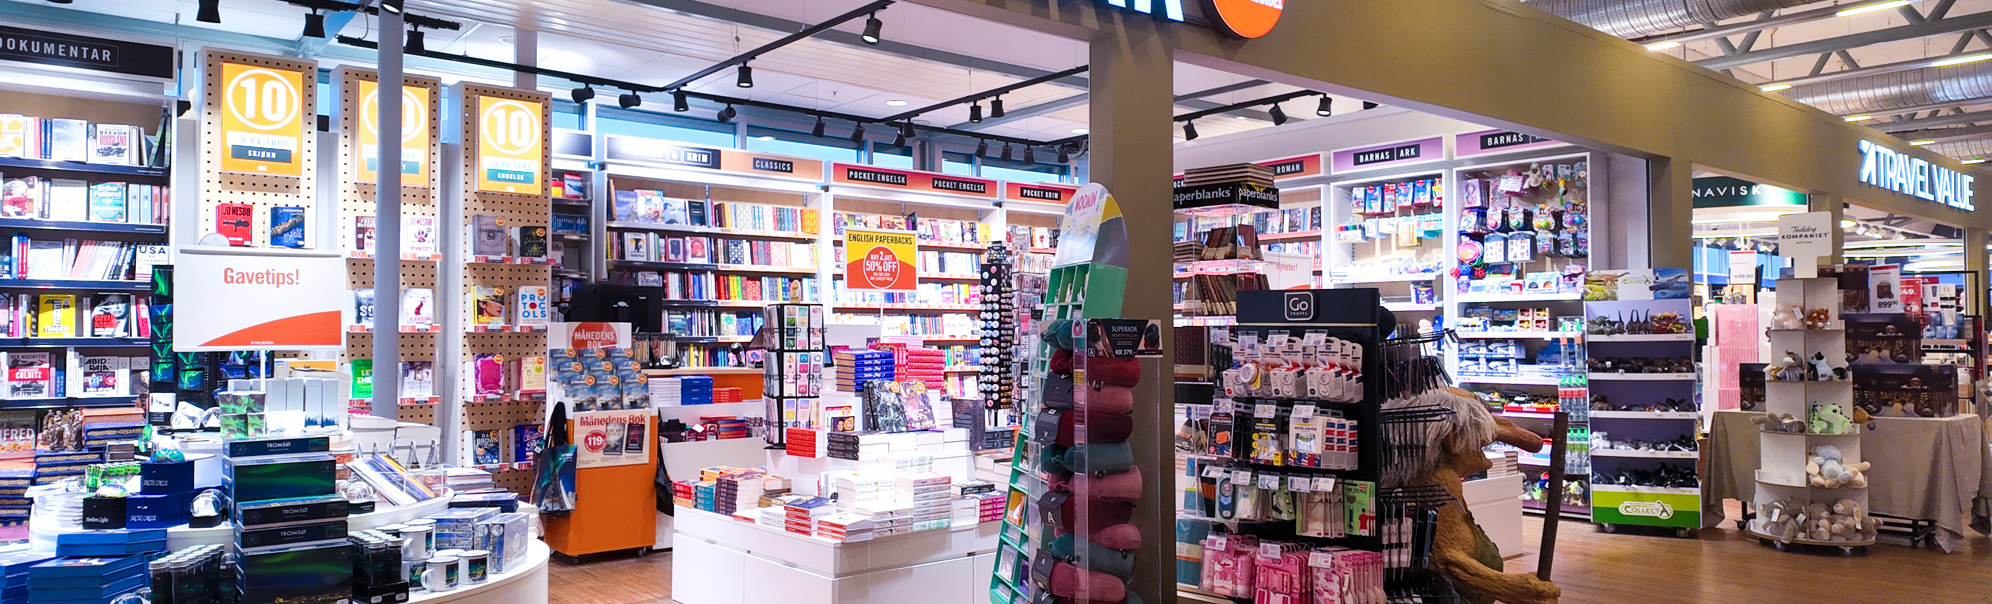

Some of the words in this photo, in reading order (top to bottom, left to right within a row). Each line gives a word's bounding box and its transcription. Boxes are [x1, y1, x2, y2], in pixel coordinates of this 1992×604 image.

[0, 37, 111, 62] OKUMENTAR
[240, 77, 286, 122] 10
[491, 108, 530, 148] 10
[1487, 133, 1524, 146] BARNAS
[686, 152, 708, 163] KRIM
[1359, 151, 1390, 163] BARNAS
[1399, 147, 1416, 158] ARK
[755, 160, 791, 171] CLASSICS
[1276, 162, 1301, 174] ROMAN
[497, 172, 525, 181] ENGELSK
[849, 170, 875, 181] POCKET
[877, 173, 906, 184] ENGELSK
[1875, 145, 1935, 201] TRAVEL
[1931, 163, 1975, 212] VALUE
[933, 180, 957, 189] POCKET
[958, 182, 985, 192] ENGELSK
[1692, 185, 1762, 198] NAVISK
[1022, 189, 1044, 198] POCKET
[1045, 190, 1059, 199] KRIM
[1173, 187, 1231, 206] aperblanks
[1238, 187, 1278, 202] paperblanks
[222, 206, 231, 216] JO
[231, 206, 251, 216] NESBØ
[848, 233, 874, 243] ENGLISH
[875, 235, 913, 245] PAPERBACKS
[1781, 232, 1828, 240] KOMPANIET
[139, 246, 166, 255] USA
[879, 250, 884, 261] 2
[865, 260, 882, 272] 50%
[882, 261, 897, 272] OFF
[1276, 262, 1298, 272] Nyheter!
[223, 267, 299, 288] Gavetips!
[1289, 297, 1309, 311] Go
[1877, 301, 1892, 309] 899
[574, 328, 615, 340] MÅNEDENS
[587, 340, 602, 349] BOK
[15, 371, 42, 379] COLDITZ
[580, 415, 628, 427] Månedens
[628, 414, 646, 424] Bok
[587, 435, 603, 446] 119
[282, 507, 308, 515] TROMSØ
[280, 529, 307, 537] TROMSØ
